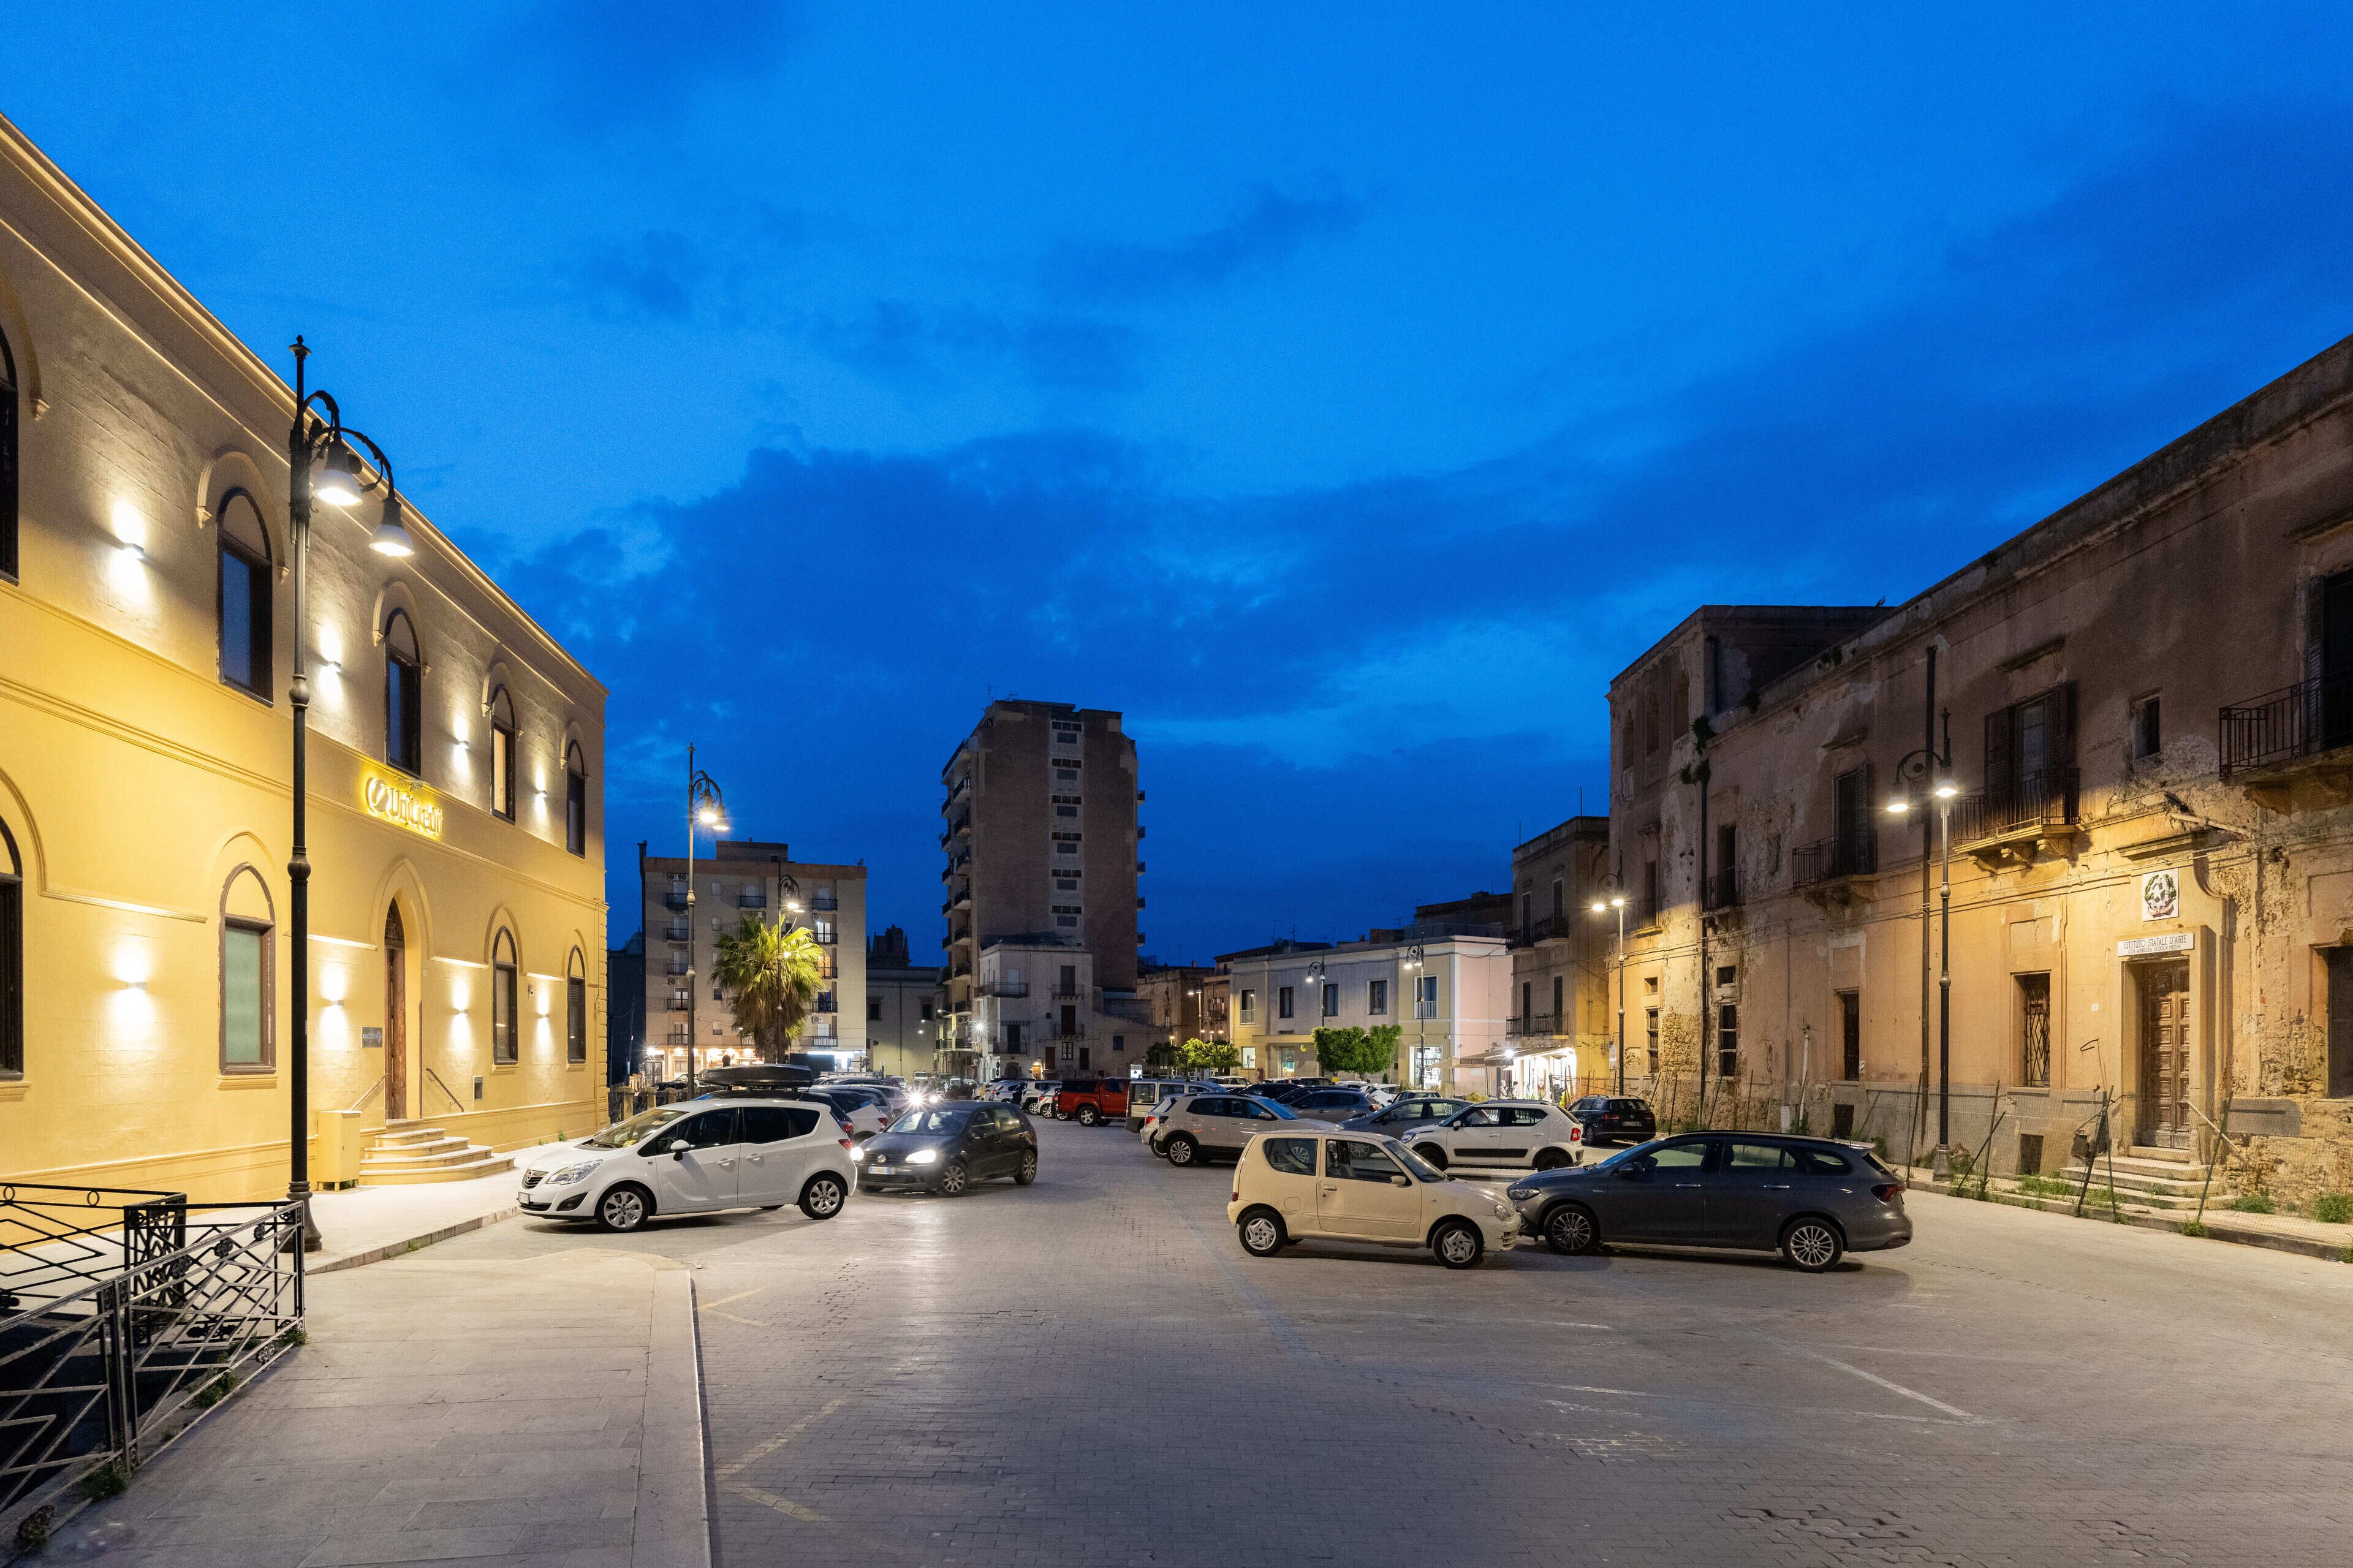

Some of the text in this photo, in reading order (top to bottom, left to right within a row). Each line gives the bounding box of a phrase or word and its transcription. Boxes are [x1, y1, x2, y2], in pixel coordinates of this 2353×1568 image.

[2124, 935, 2186, 949] ISTITUTO STATALE D'ARTE
